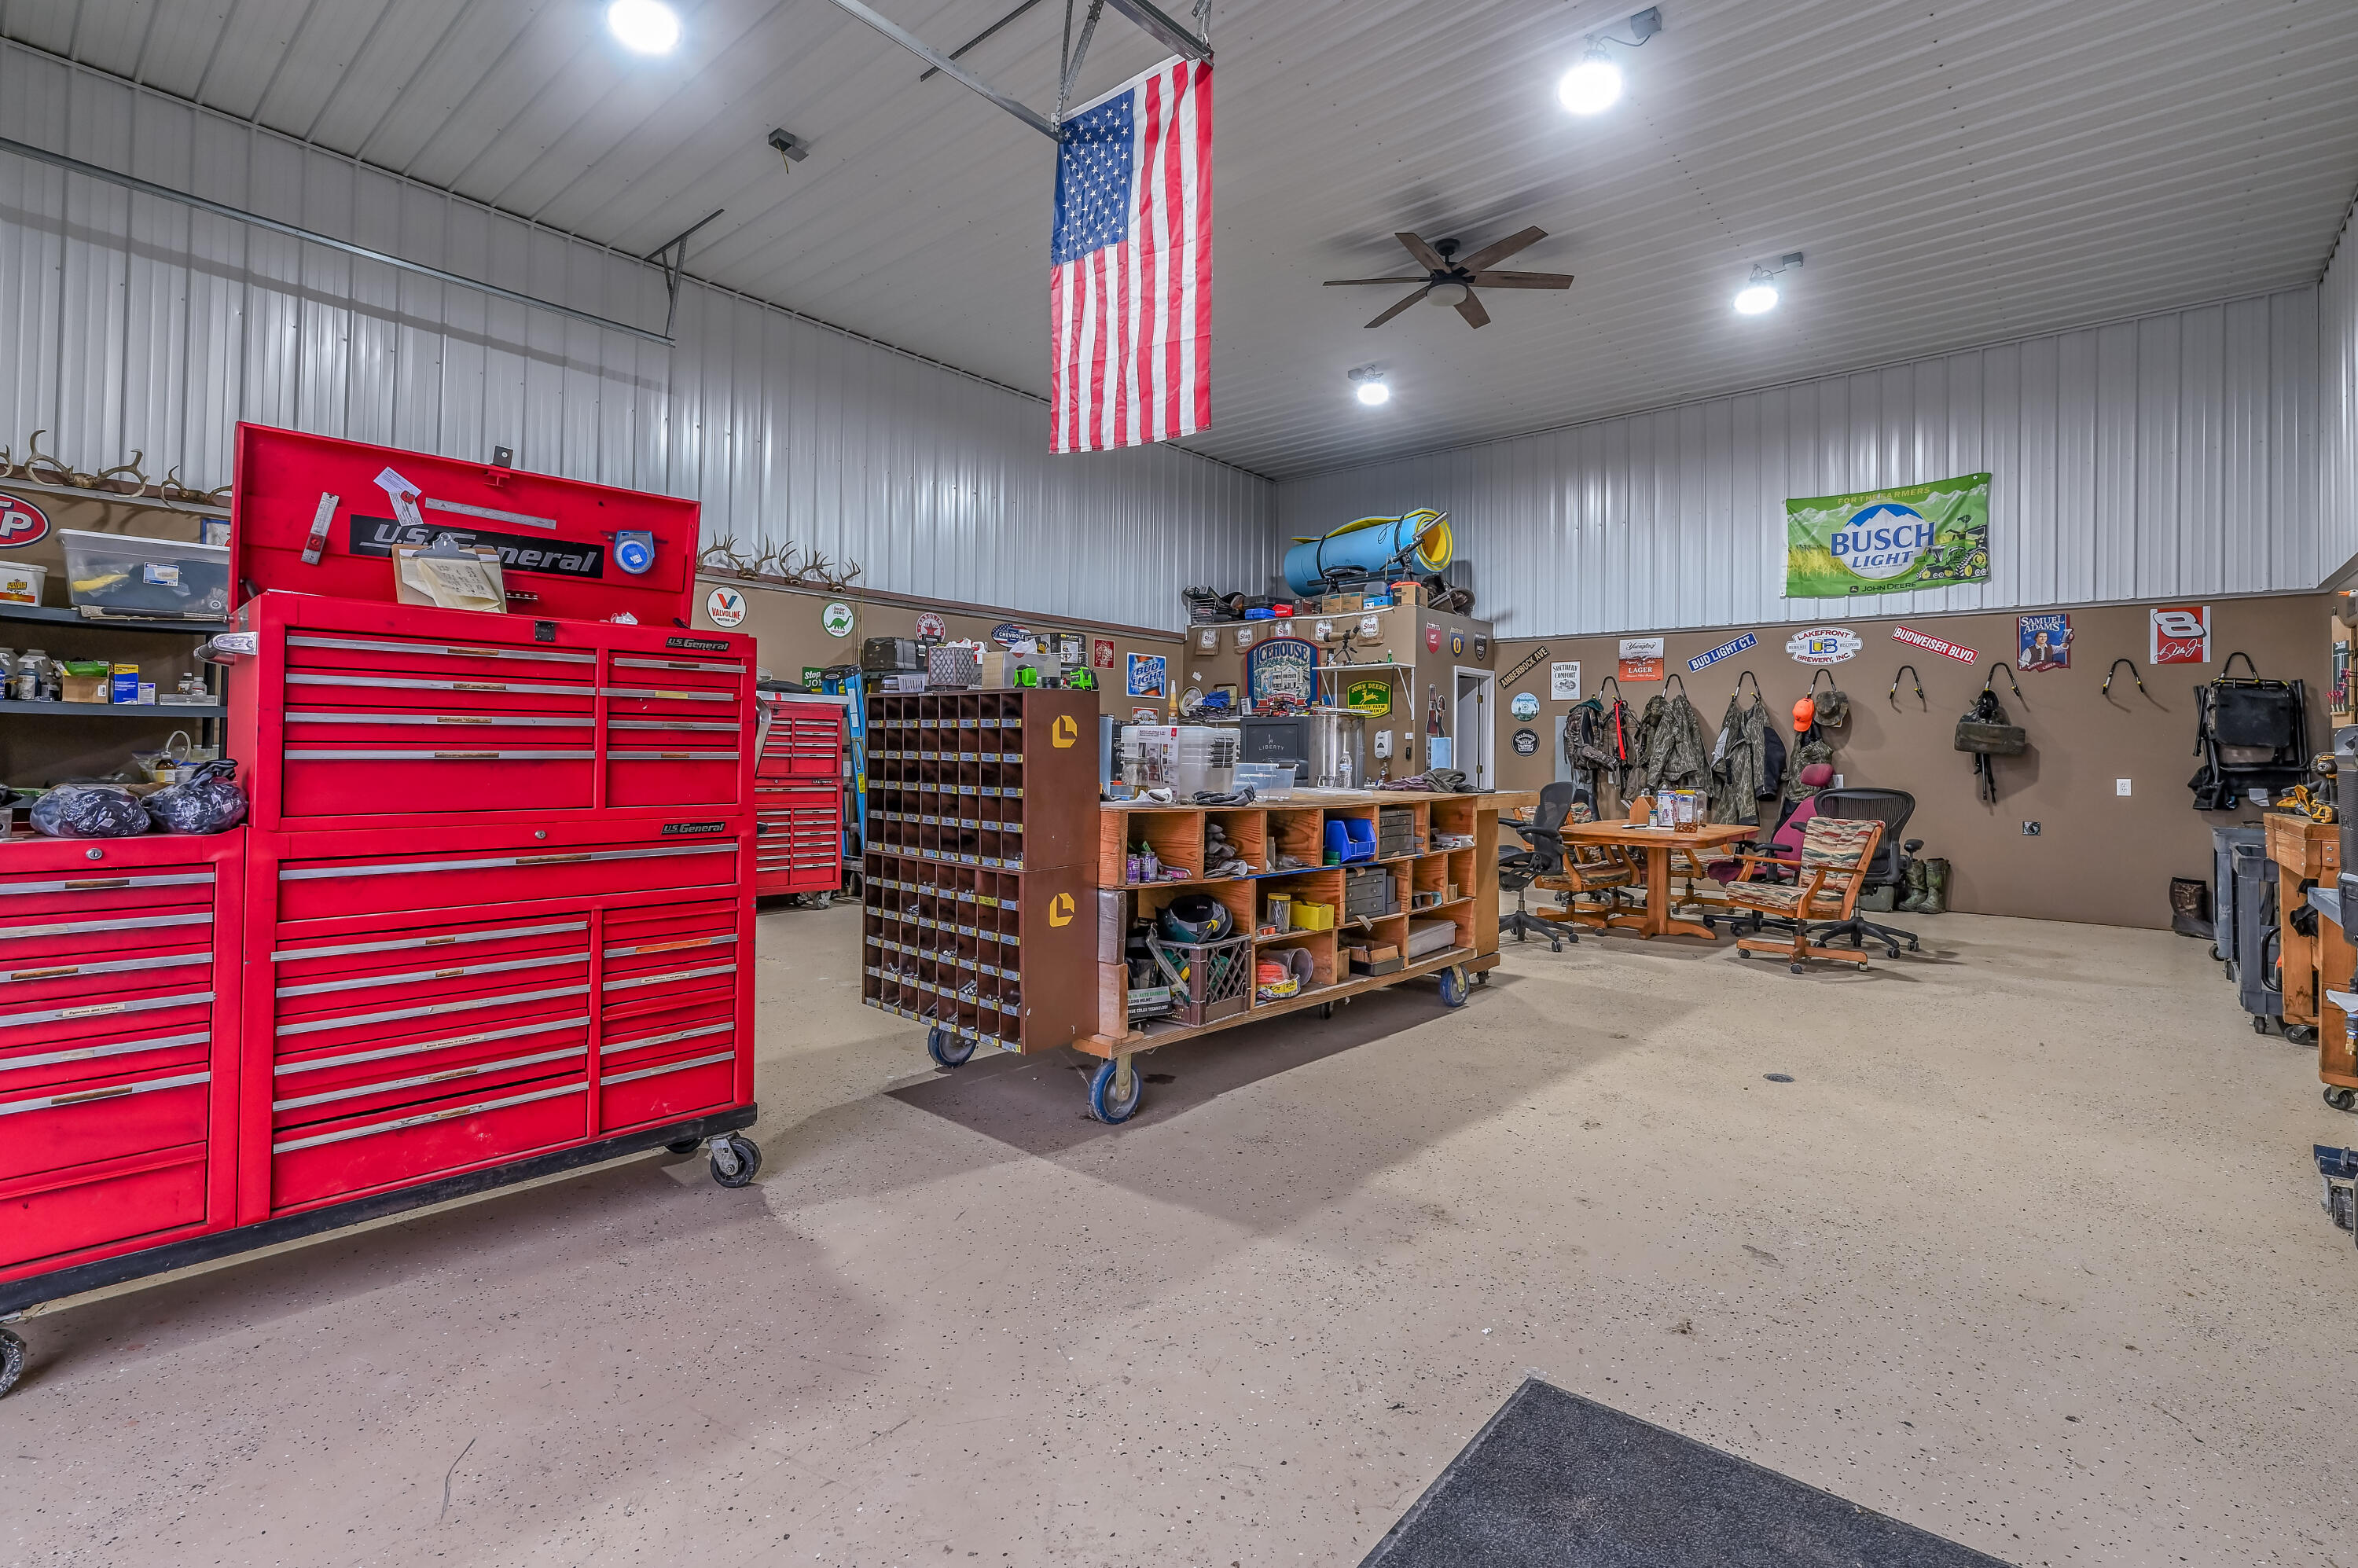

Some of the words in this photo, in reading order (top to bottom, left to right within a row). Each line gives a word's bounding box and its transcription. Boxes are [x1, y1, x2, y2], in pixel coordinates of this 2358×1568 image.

[1838, 497, 1857, 505] FOR
[1858, 494, 1878, 502] THE
[1880, 487, 1930, 499] FARMERS
[1831, 521, 1935, 556] BUSCH
[373, 523, 430, 546] U.S.
[453, 534, 597, 573] neral
[1852, 551, 1914, 568] LIGHT
[712, 608, 741, 620] VALVOLINE
[2020, 615, 2065, 627] SAMUEL
[2152, 611, 2207, 638] 8
[2023, 622, 2060, 635] ADAMS
[1797, 630, 1851, 641] LAKEFRONT
[683, 639, 729, 651] General
[1625, 641, 1657, 651] Yuengling
[1893, 628, 1950, 655] BUDWEISER
[1948, 646, 1976, 664] BLVD.
[1256, 641, 1309, 666] ICEHOUSE
[1691, 655, 1711, 670] BUD
[1712, 644, 1739, 661] LIGHT
[1739, 635, 1754, 648] CT.
[1797, 654, 1835, 663] BREWERY,
[1135, 663, 1160, 676] BUD
[1500, 655, 1537, 688] AMBERBOCK
[1533, 646, 1548, 662] AVE
[1552, 664, 1578, 673] SOUTHERN
[1131, 670, 1164, 687] LIGHT
[1351, 683, 1367, 693] JOHN
[1368, 682, 1387, 692] DEERE
[679, 823, 725, 833] General
